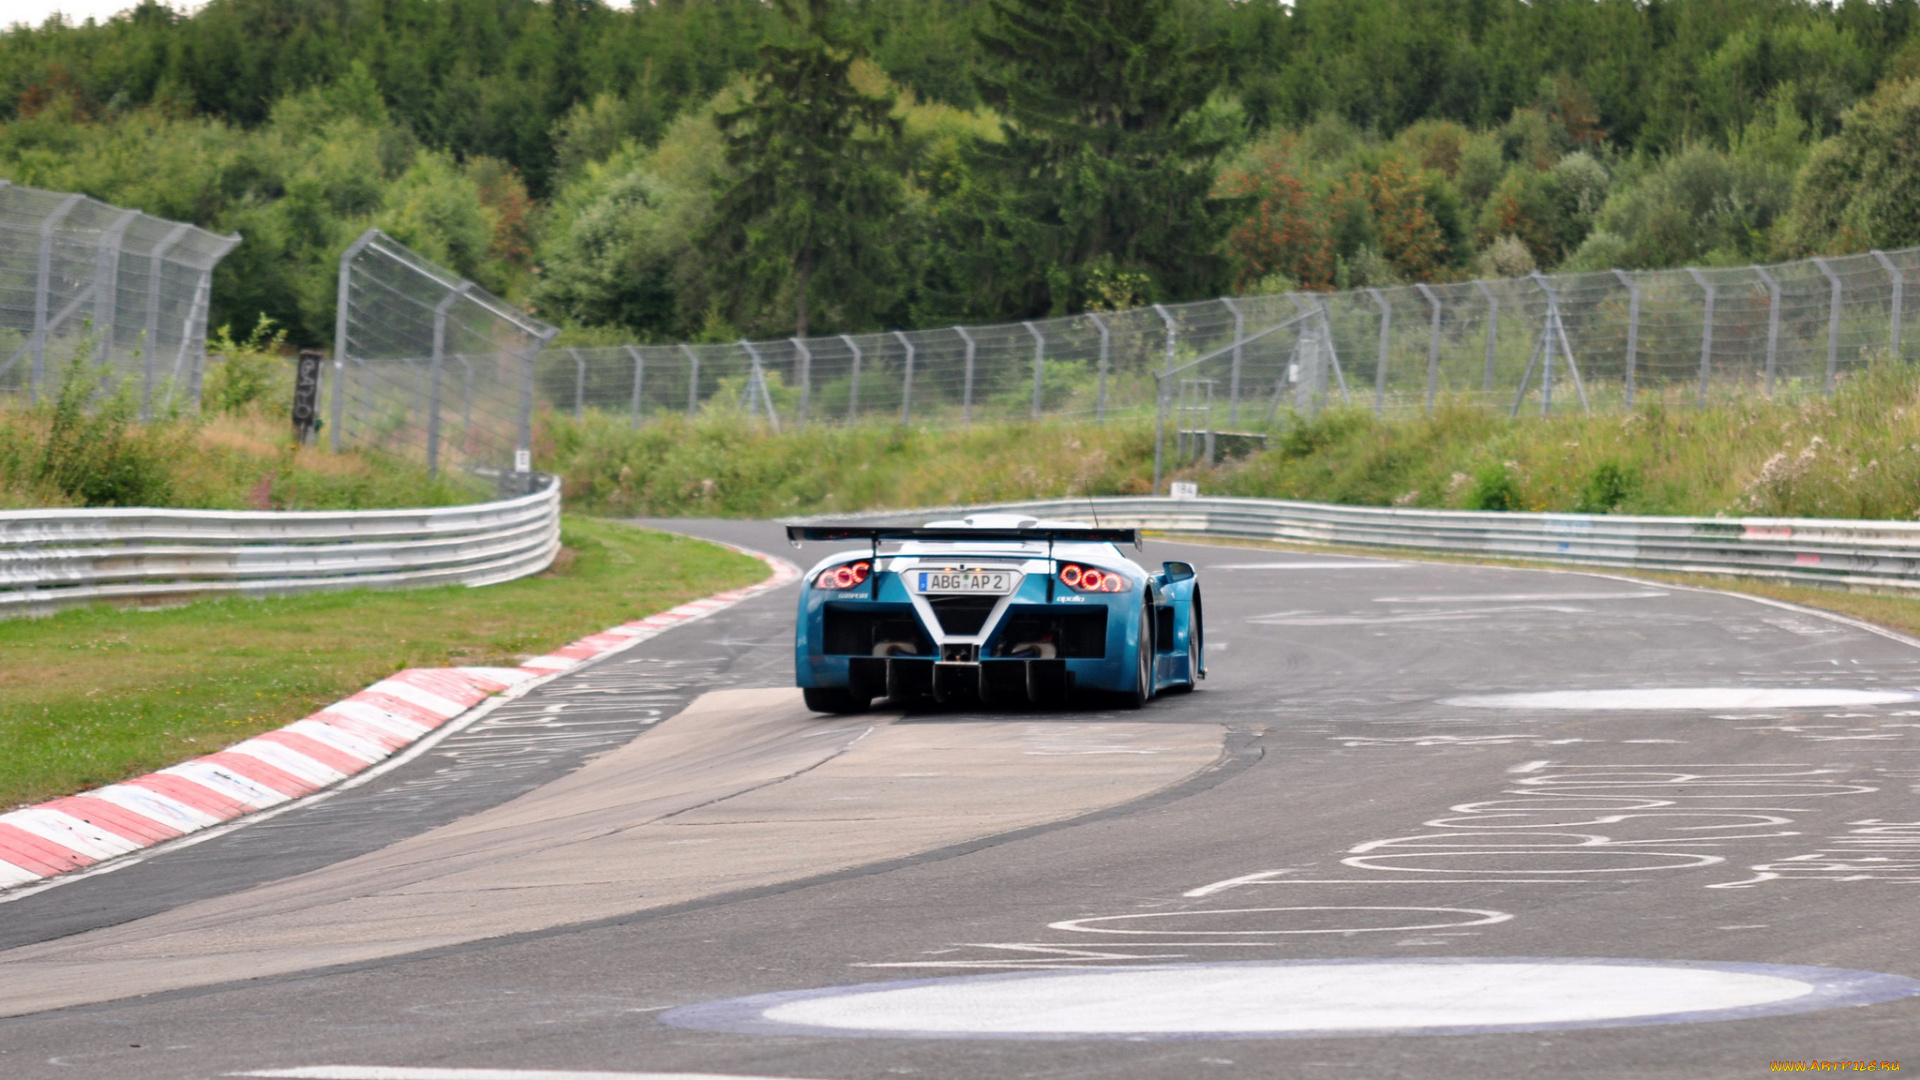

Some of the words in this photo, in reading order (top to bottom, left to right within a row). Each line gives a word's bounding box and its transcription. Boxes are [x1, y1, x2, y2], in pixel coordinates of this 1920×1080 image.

[931, 575, 960, 589] ABG
[971, 575, 991, 589] AP
[993, 575, 1002, 589] 2
